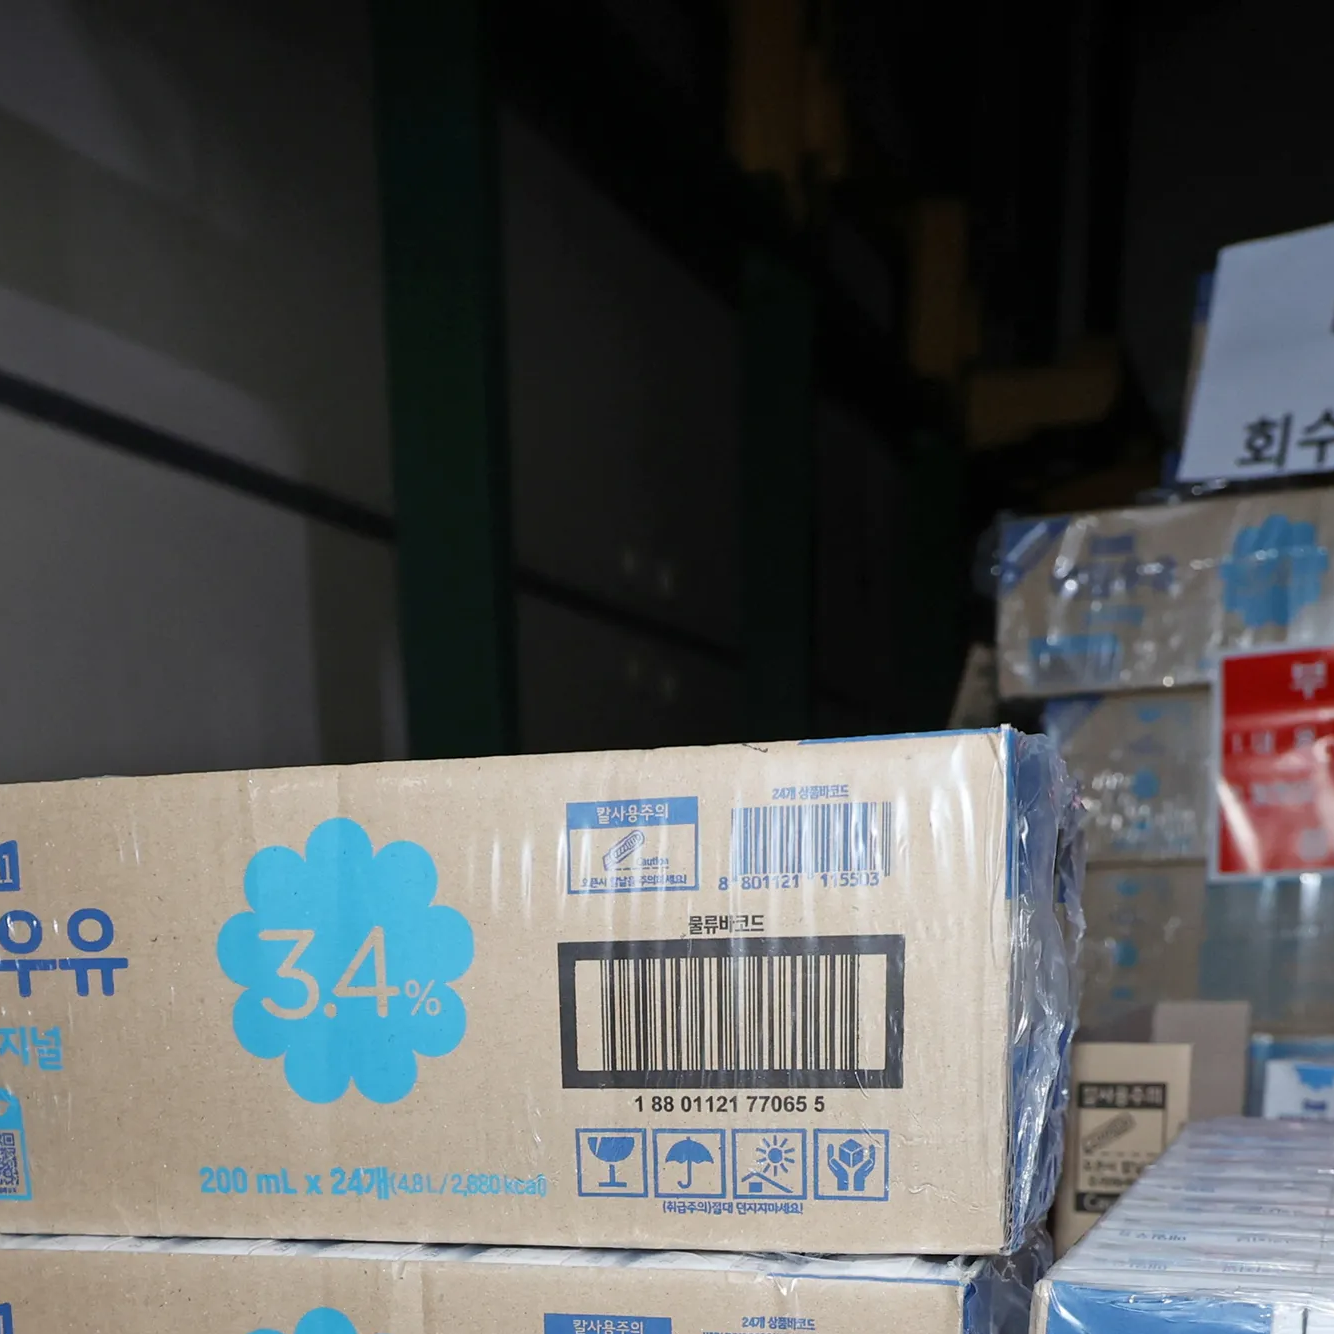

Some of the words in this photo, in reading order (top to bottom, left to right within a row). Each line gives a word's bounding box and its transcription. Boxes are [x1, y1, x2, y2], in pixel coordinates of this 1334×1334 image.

[596, 804, 669, 824] 칼사용주의
[688, 914, 765, 935] 물류바코드
[651, 1096, 674, 1112] 88
[681, 1096, 738, 1112] 01121
[746, 1096, 807, 1112] 77065
[199, 1166, 248, 1194] 200
[256, 1168, 297, 1195] mL
[741, 1317, 765, 1329] 24개
[768, 1317, 816, 1331] 상품바코드
